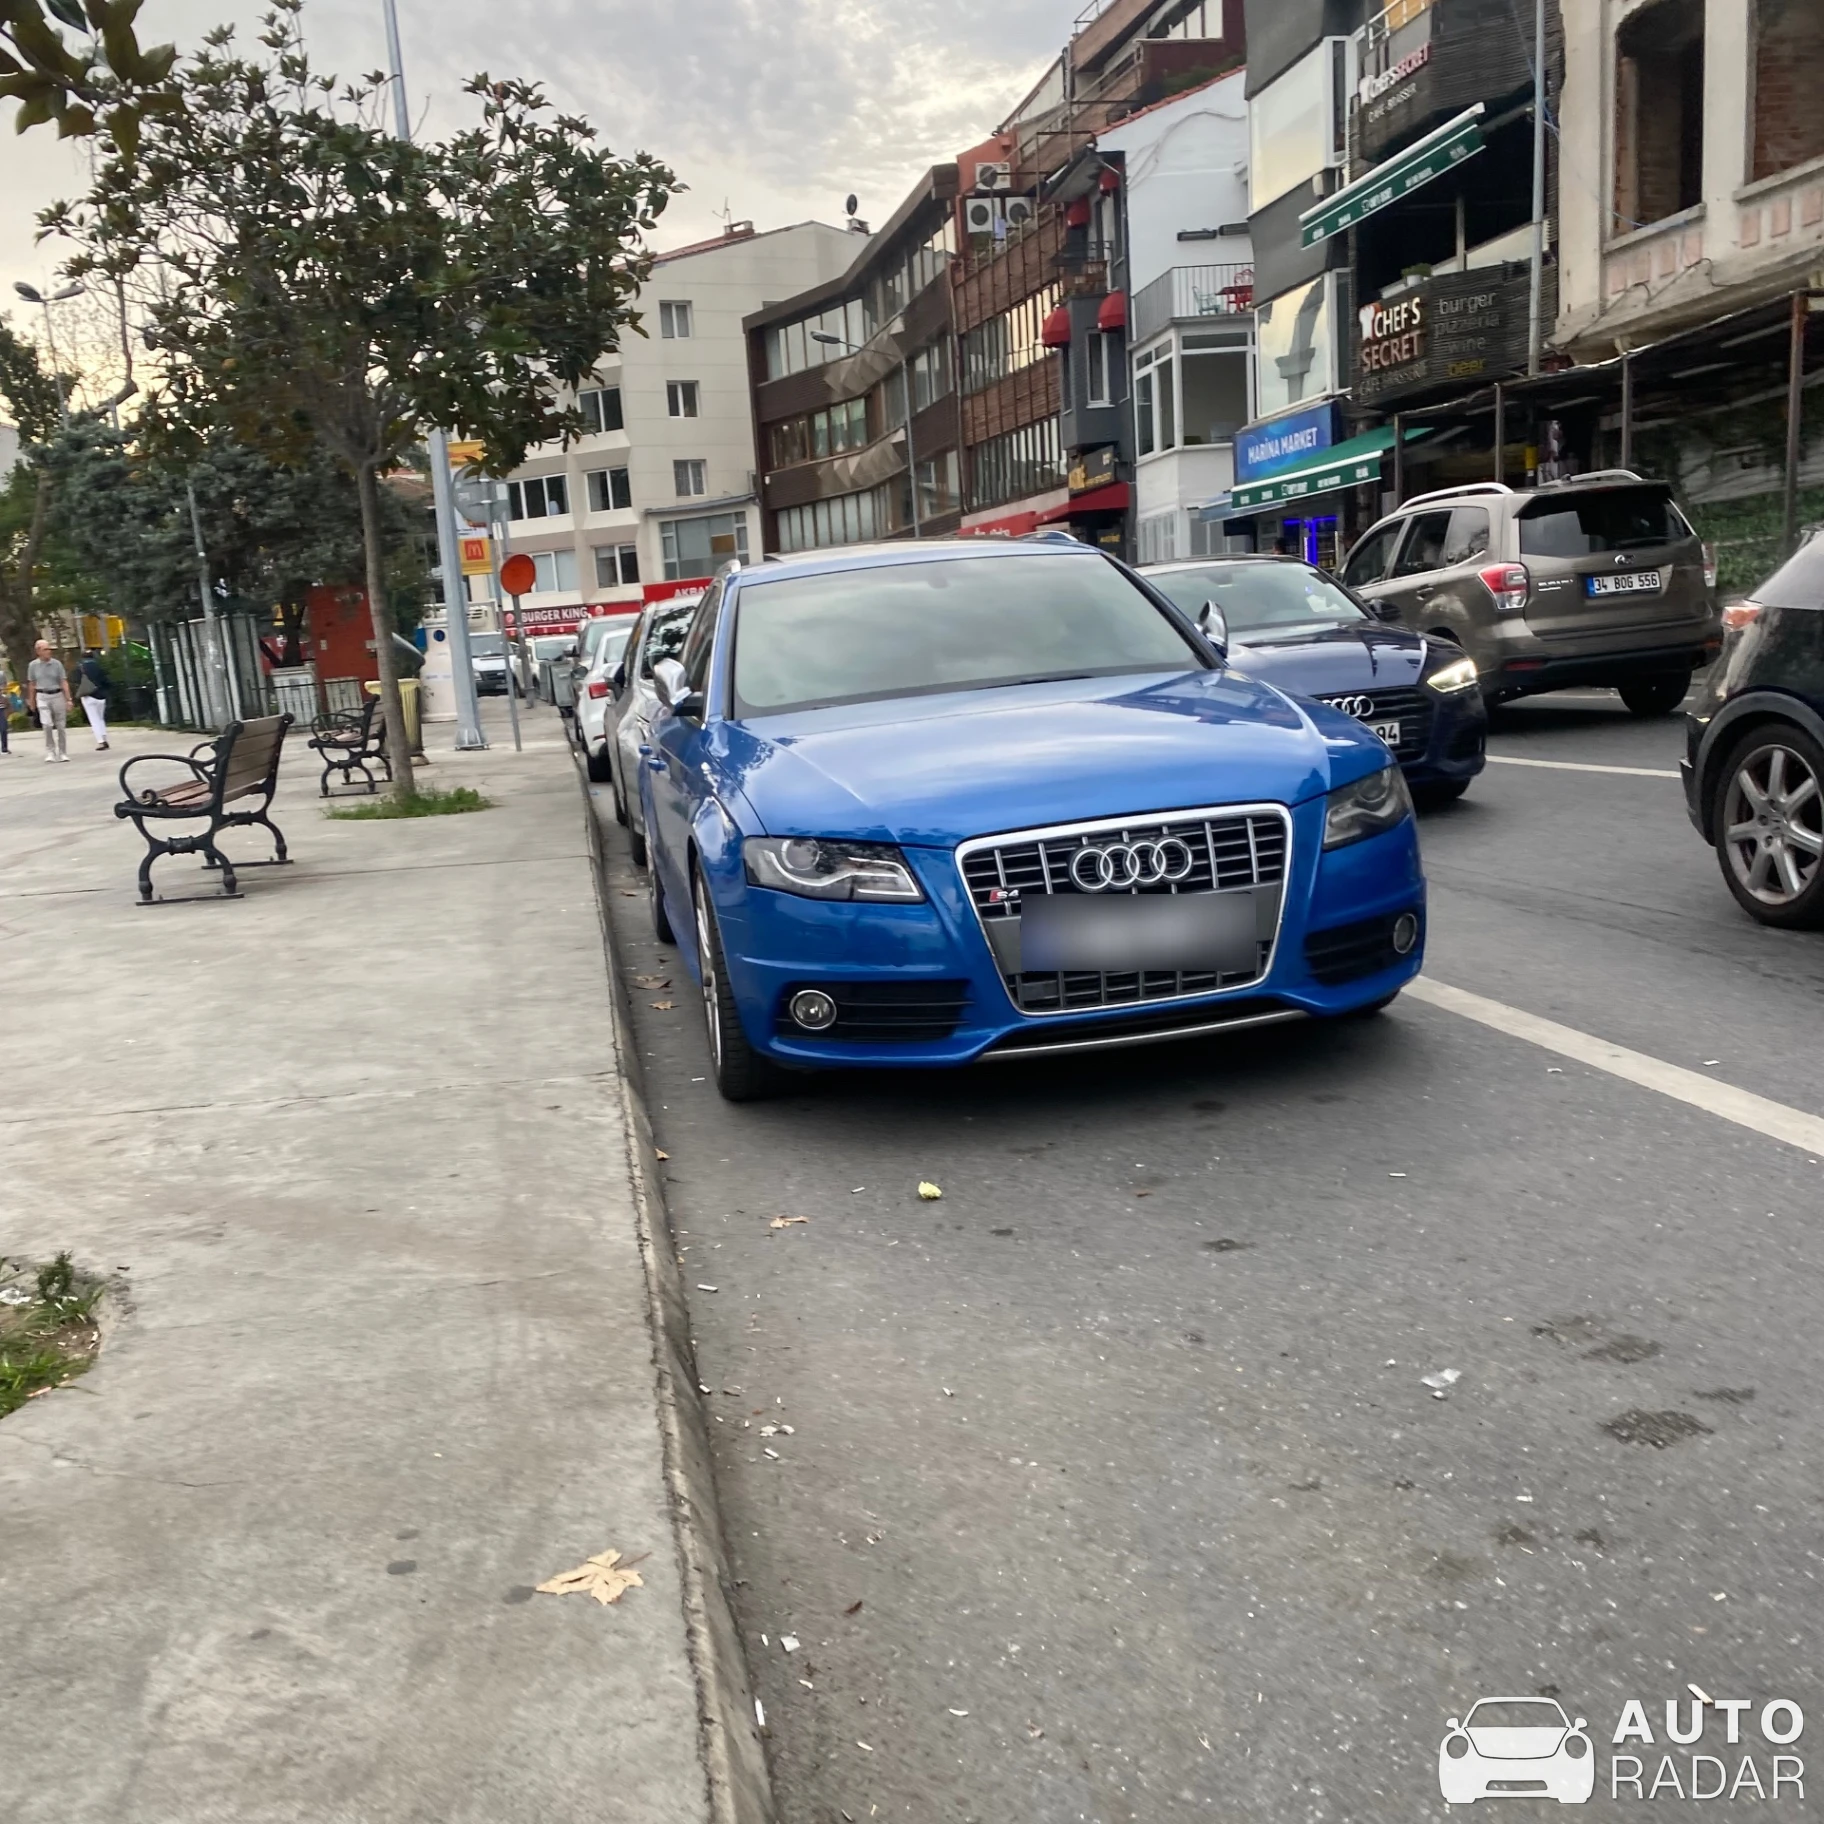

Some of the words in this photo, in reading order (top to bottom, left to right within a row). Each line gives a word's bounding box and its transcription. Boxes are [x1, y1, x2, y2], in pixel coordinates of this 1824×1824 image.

[1439, 292, 1497, 315] burger
[1374, 297, 1421, 338] CHEF'S
[1361, 330, 1422, 374] SECRET
[1281, 426, 1318, 455] MARKET
[1595, 577, 1608, 591] 34
[1638, 572, 1658, 588] 556
[521, 608, 561, 622] BURGER
[561, 606, 588, 620] KING
[997, 889, 1020, 900] S4
